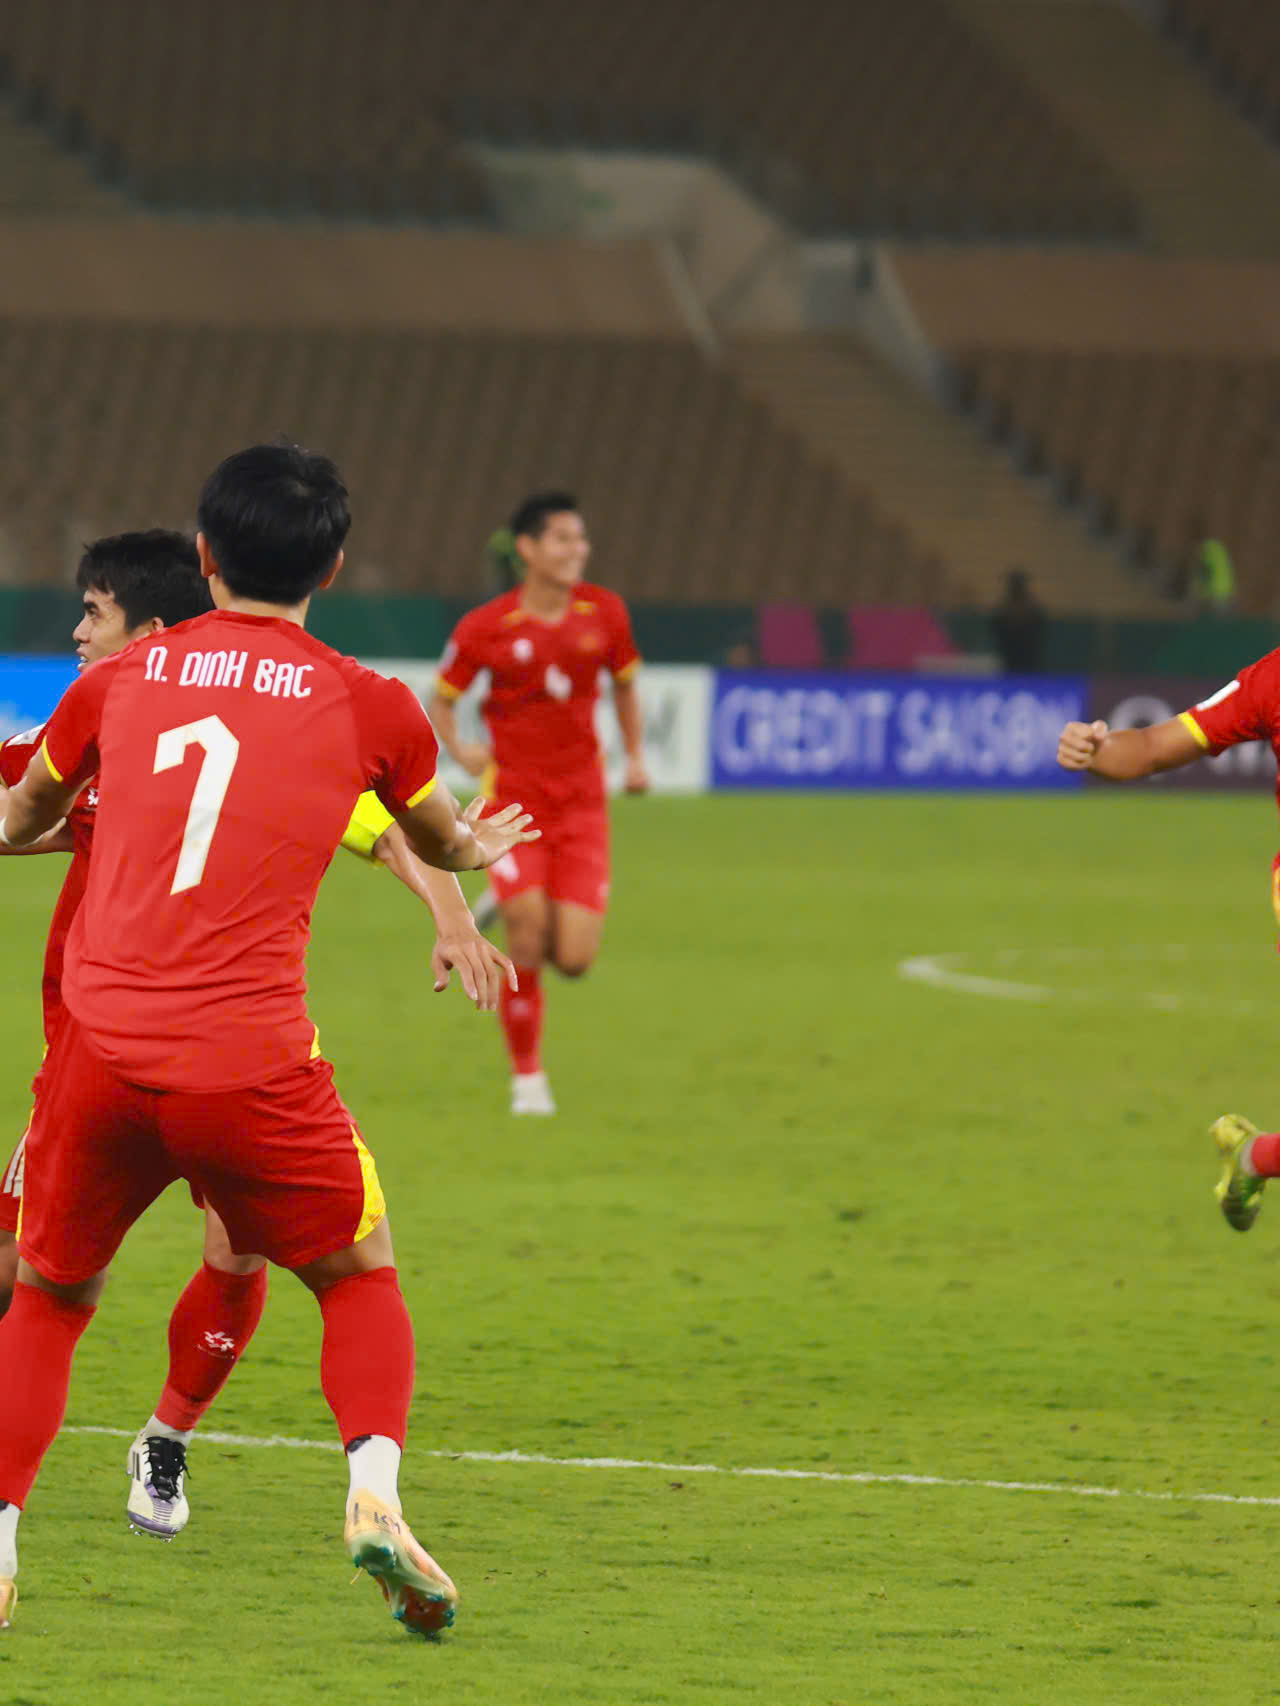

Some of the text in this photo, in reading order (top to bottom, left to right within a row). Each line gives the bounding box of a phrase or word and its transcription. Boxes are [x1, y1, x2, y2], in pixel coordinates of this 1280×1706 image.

[178, 650, 248, 688] DINH
[253, 658, 314, 699] BAC
[718, 686, 893, 775] CREDIT
[896, 688, 1084, 778] SAISON
[153, 714, 240, 896] 7
